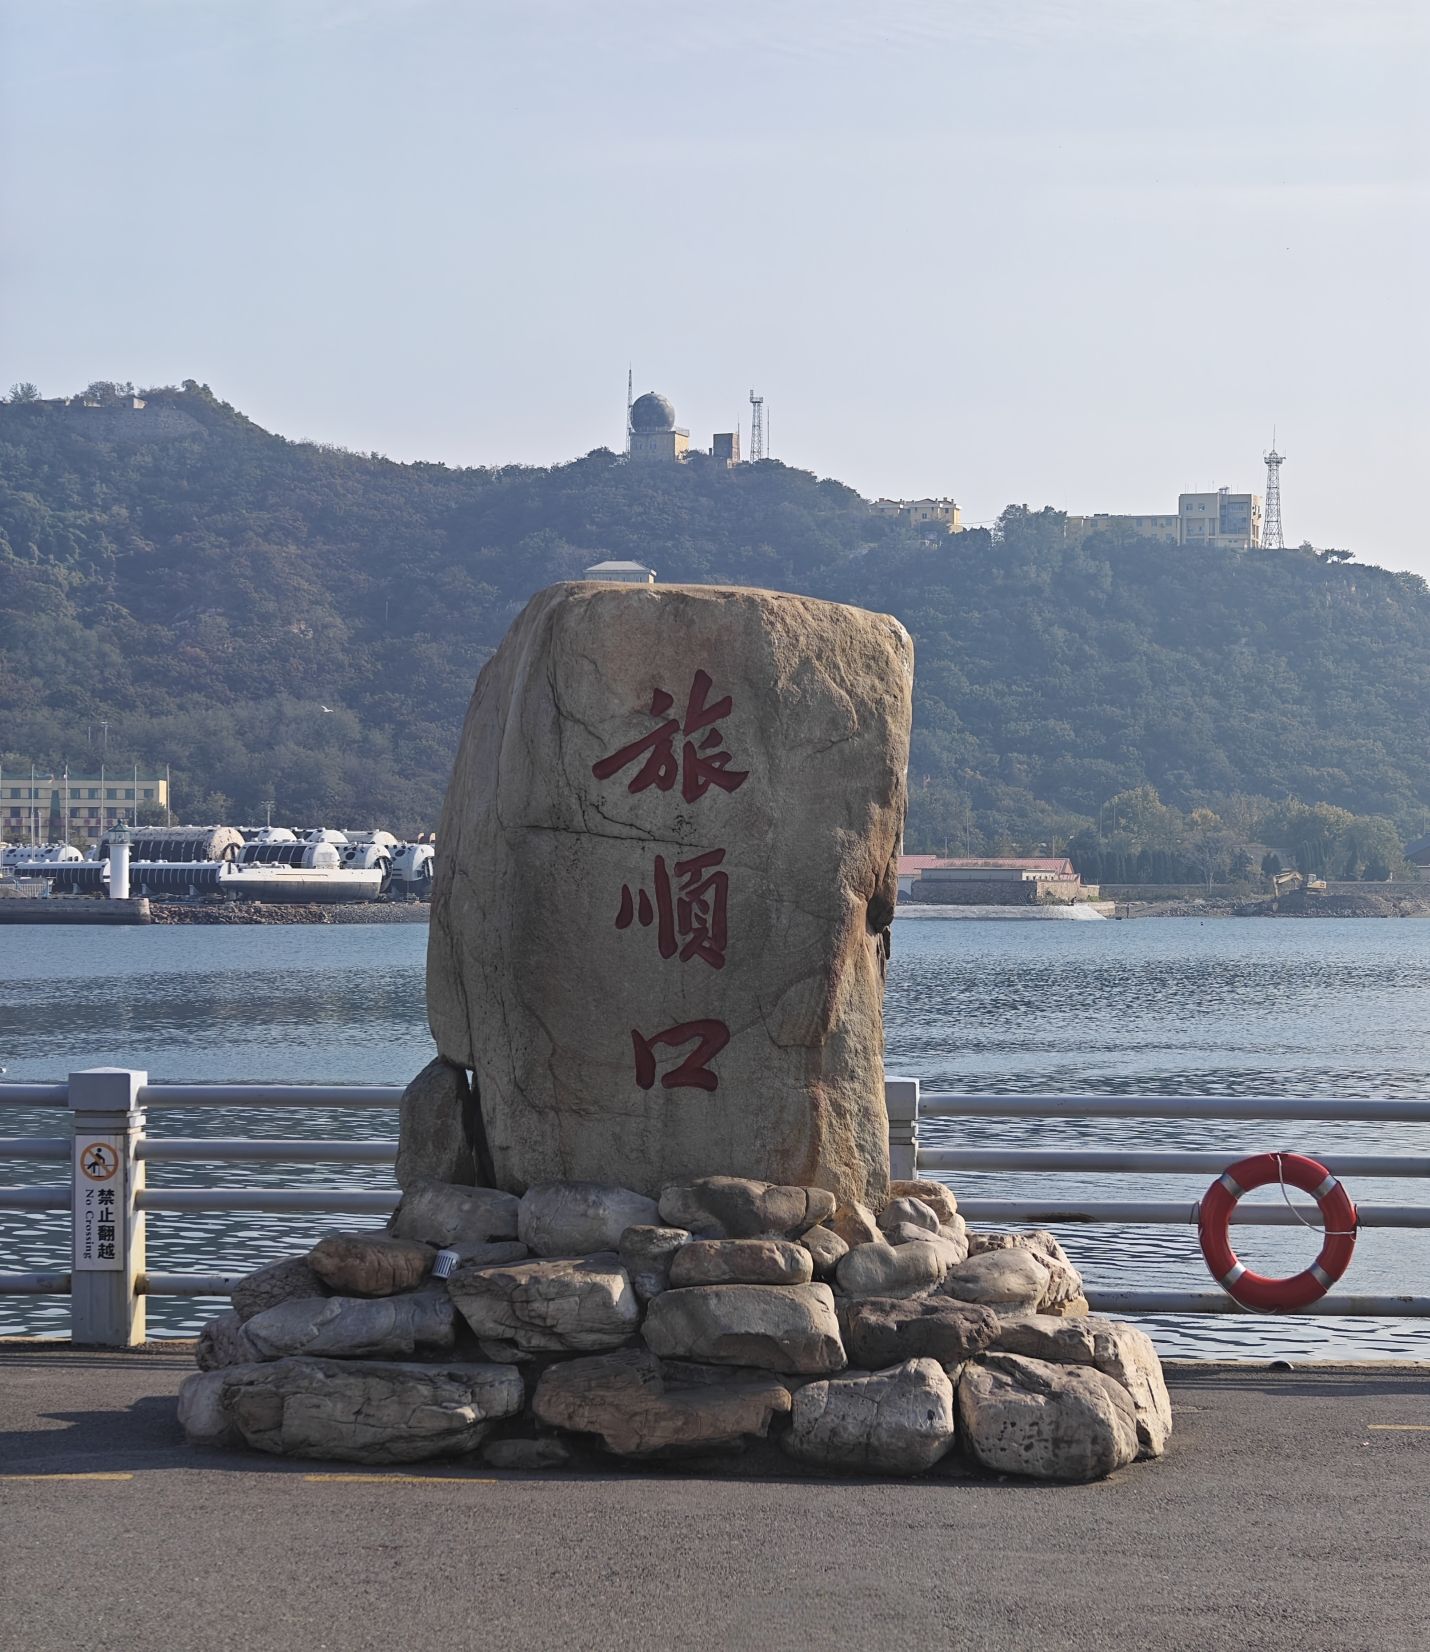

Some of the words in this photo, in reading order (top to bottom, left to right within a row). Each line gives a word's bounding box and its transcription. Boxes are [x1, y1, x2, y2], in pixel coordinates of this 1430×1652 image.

[85, 1189, 94, 1206] No
[83, 1210, 94, 1259] Crossing
[97, 1188, 115, 1260] 禁止翻越
